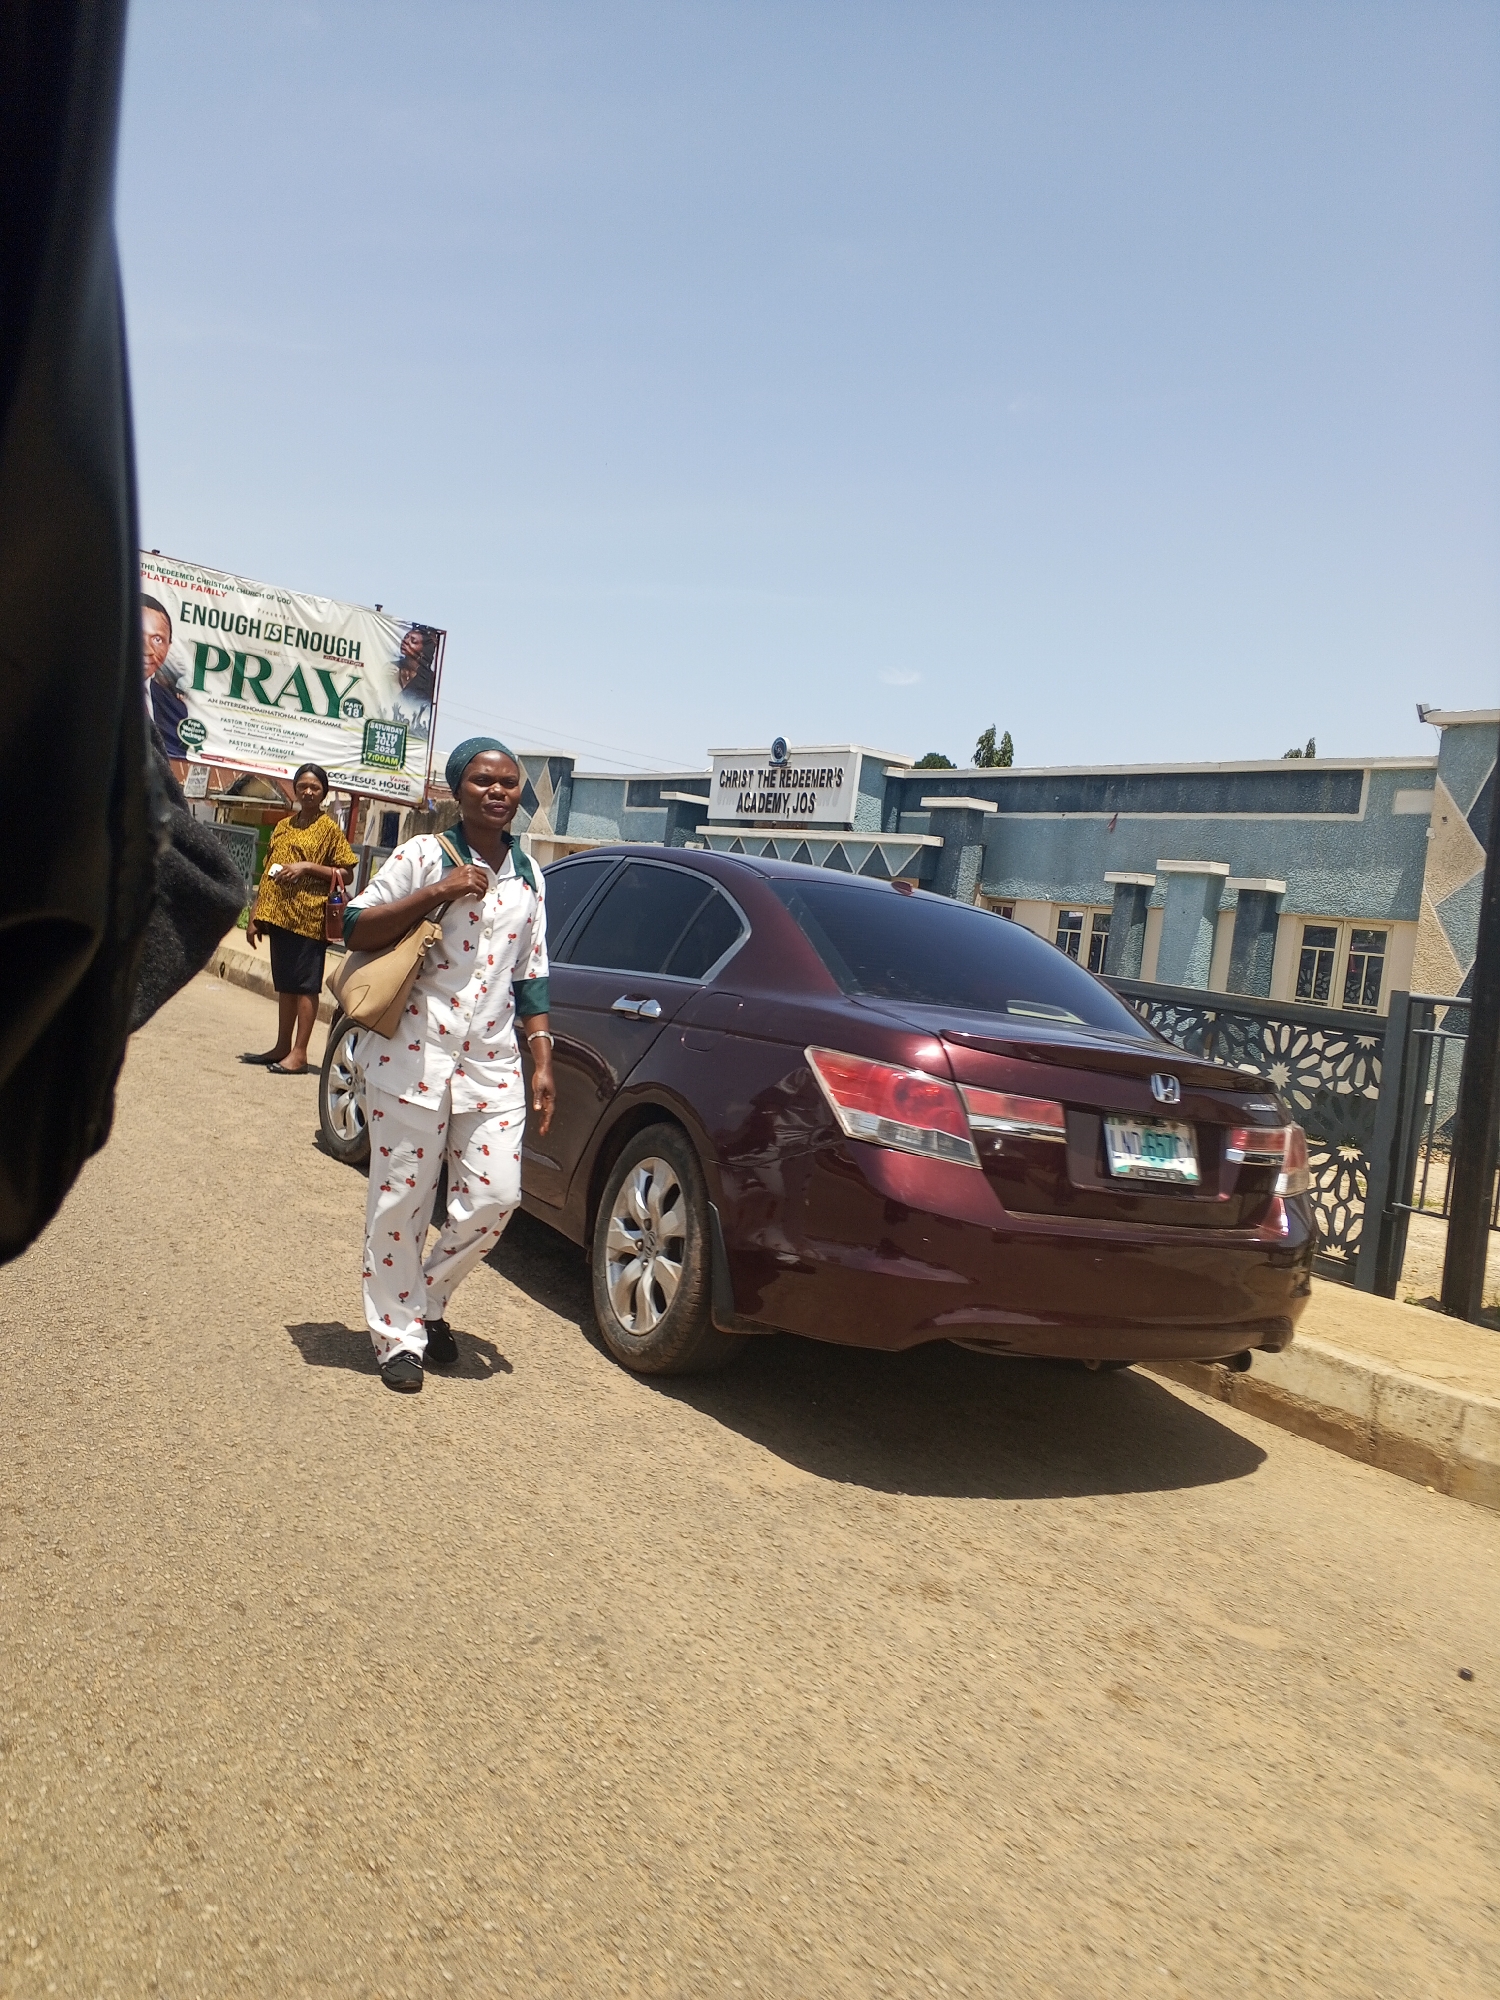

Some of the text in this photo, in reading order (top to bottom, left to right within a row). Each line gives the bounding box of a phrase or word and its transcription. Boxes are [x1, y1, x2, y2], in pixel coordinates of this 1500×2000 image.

[140, 570, 228, 598] PLATEAU FAMILY
[141, 562, 155, 572] THE
[156, 566, 194, 581] REDEEMED
[197, 576, 234, 591] CHRISTIAN
[236, 588, 264, 598] CHURCH
[277, 597, 292, 605] GOD
[180, 600, 361, 661] ENOUGH IS ENOUGH
[190, 639, 362, 721] PRAY
[344, 702, 362, 710] PART
[220, 700, 298, 720] INTERDENOMINATIONAL
[300, 716, 341, 728] PROGRAMME
[346, 708, 360, 718] 18
[220, 717, 242, 726] PASTOR
[370, 723, 404, 734] SATURDAY
[375, 731, 398, 742] 11TH
[376, 738, 398, 748] JULY
[228, 739, 250, 748] PASTOR
[367, 752, 399, 766] 7:00AM
[720, 767, 844, 788] CHRIST THE REDEEMER'S
[379, 780, 410, 792] HOUSE
[736, 792, 816, 818] ACADEMY, JOS
